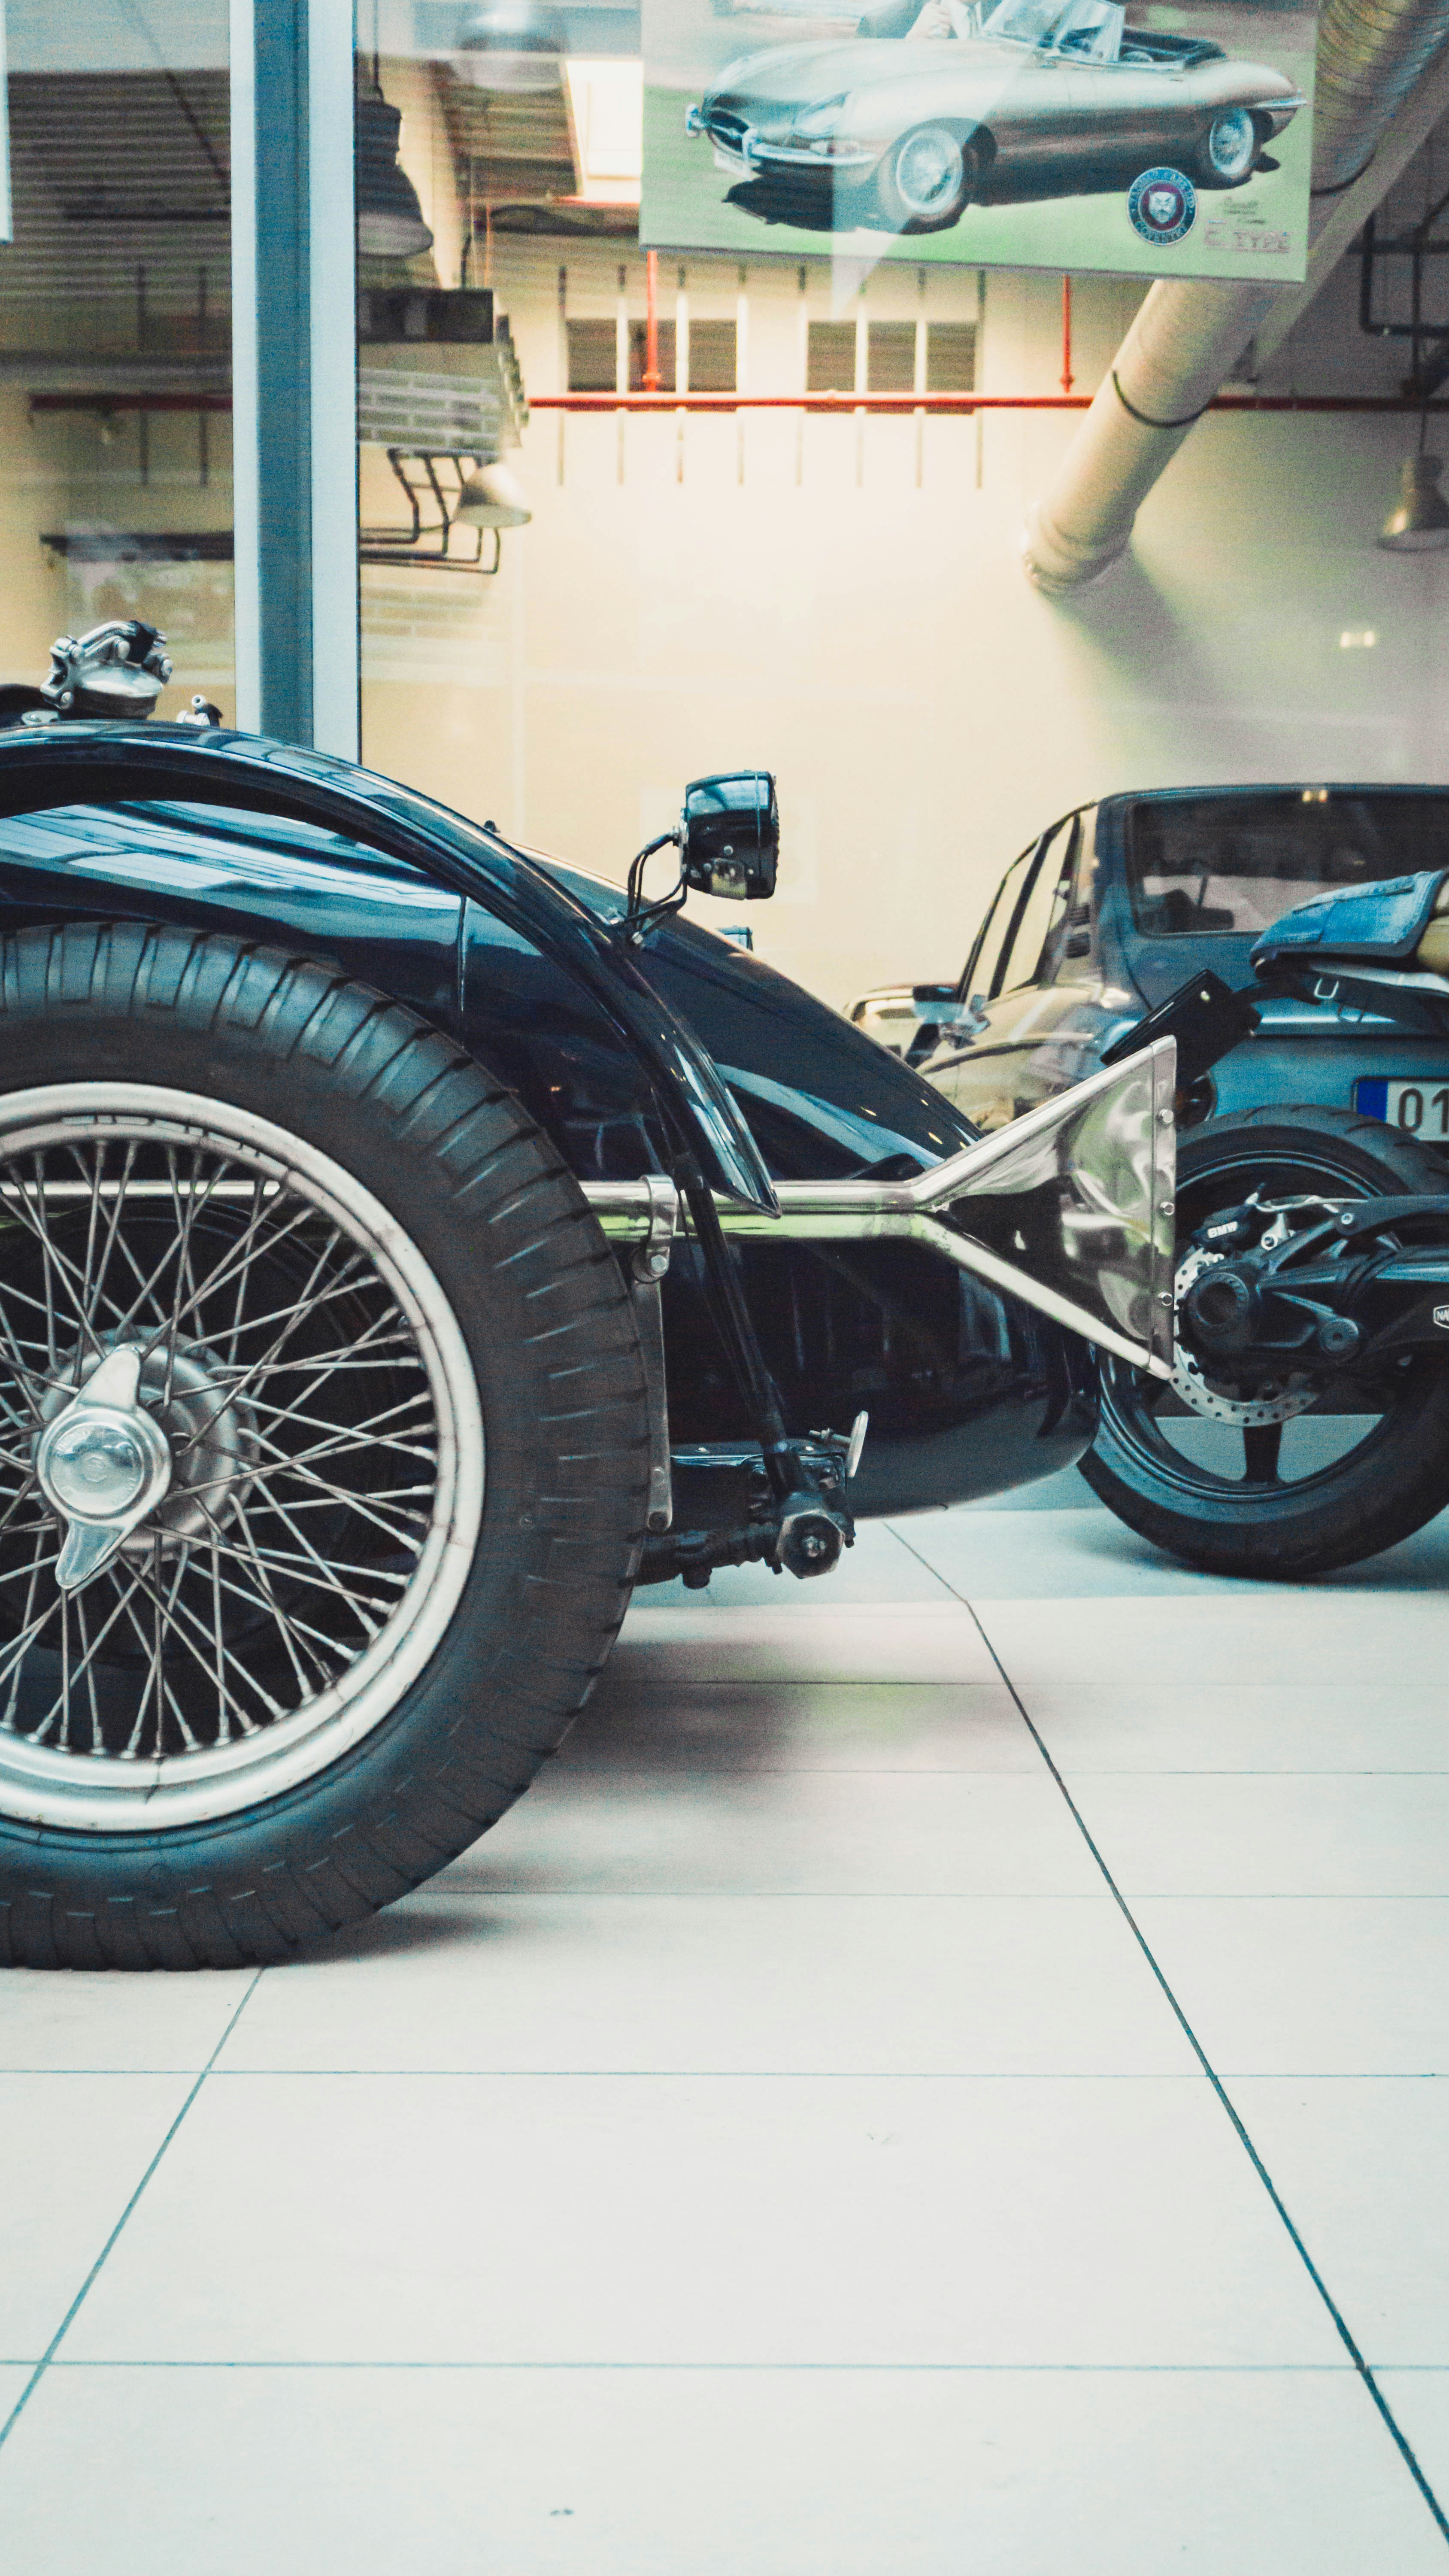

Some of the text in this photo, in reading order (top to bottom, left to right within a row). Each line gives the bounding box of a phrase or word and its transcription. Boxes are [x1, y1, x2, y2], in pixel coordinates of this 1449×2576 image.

[1398, 1088, 1449, 1135] 01
[1208, 1221, 1238, 1239] BMW
[1437, 1309, 1449, 1322] NA
